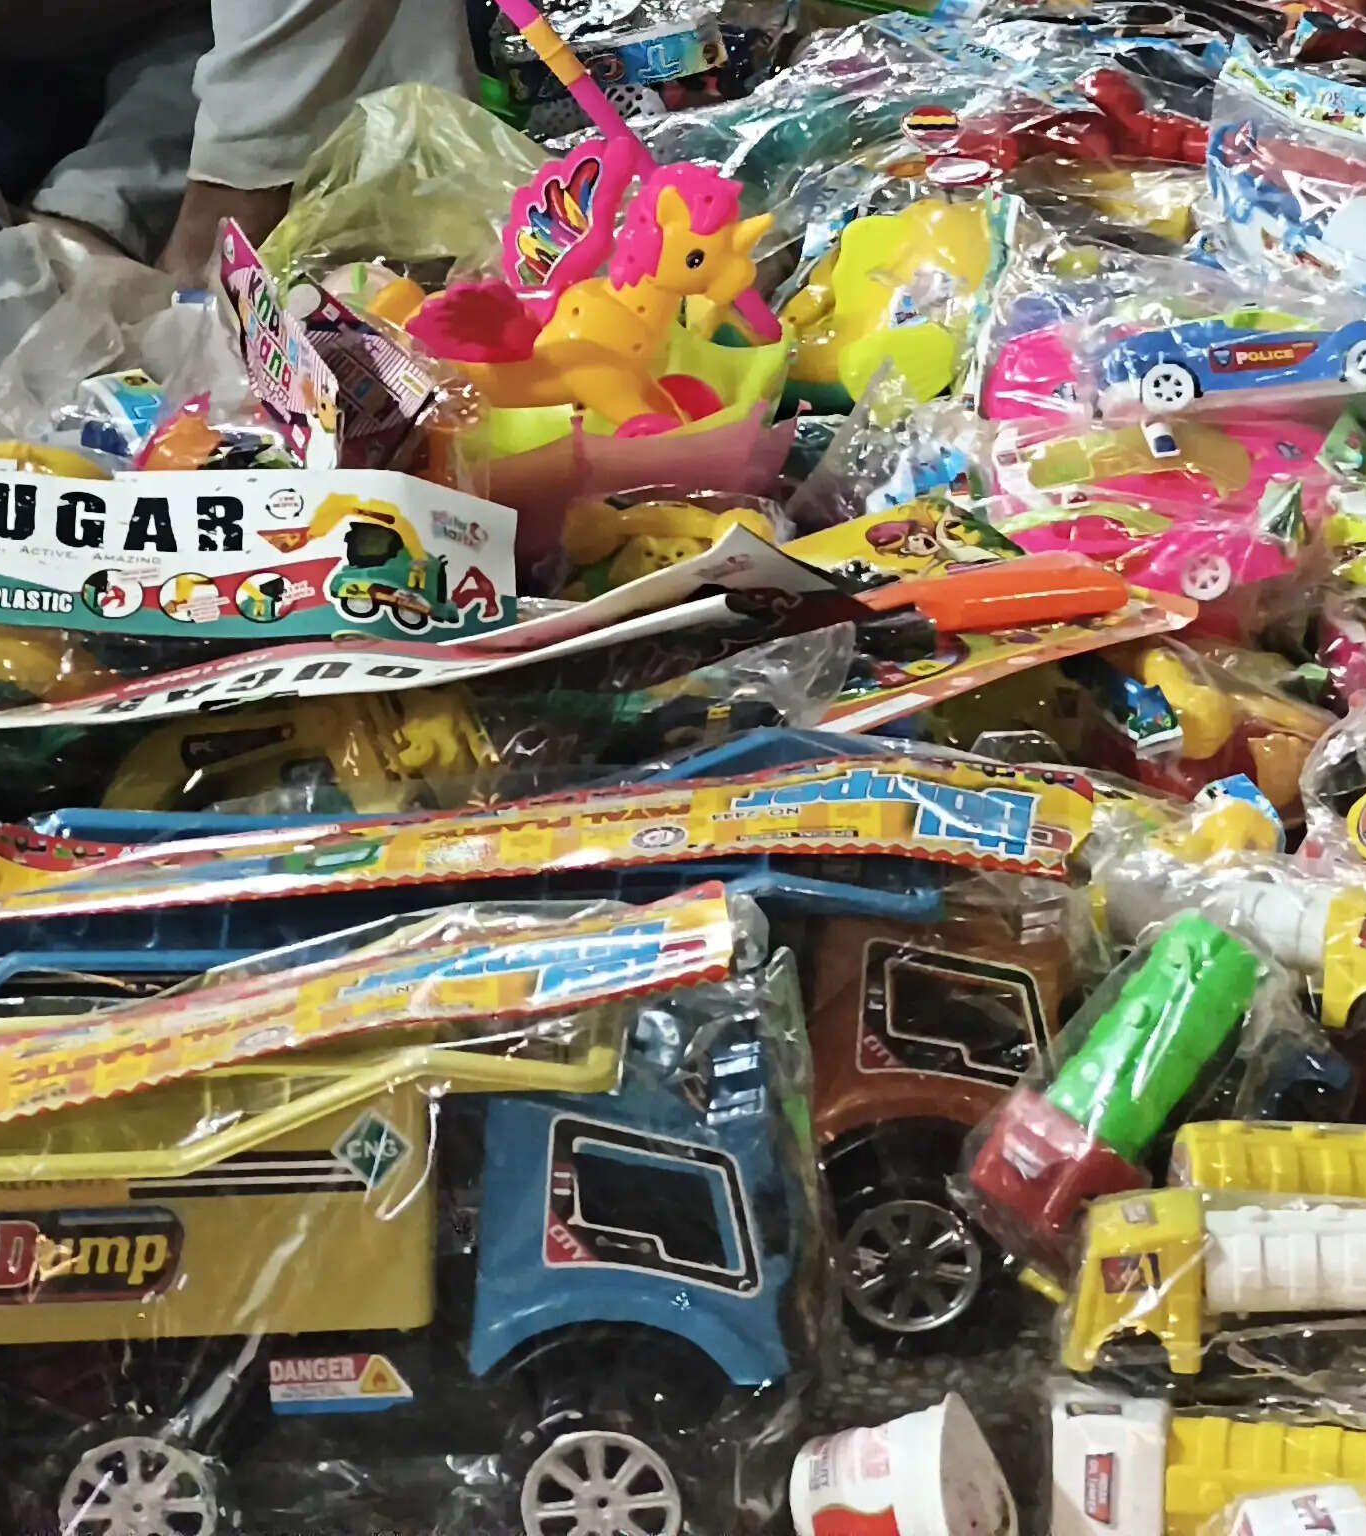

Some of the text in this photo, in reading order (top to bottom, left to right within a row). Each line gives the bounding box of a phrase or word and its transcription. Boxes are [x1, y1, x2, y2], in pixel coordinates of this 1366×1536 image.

[1235, 348, 1295, 365] POLICE
[93, 552, 162, 565] AMAZING
[346, 1138, 400, 1159] CNG
[549, 1223, 589, 1261] CITY
[269, 1357, 356, 1384] DANGER
